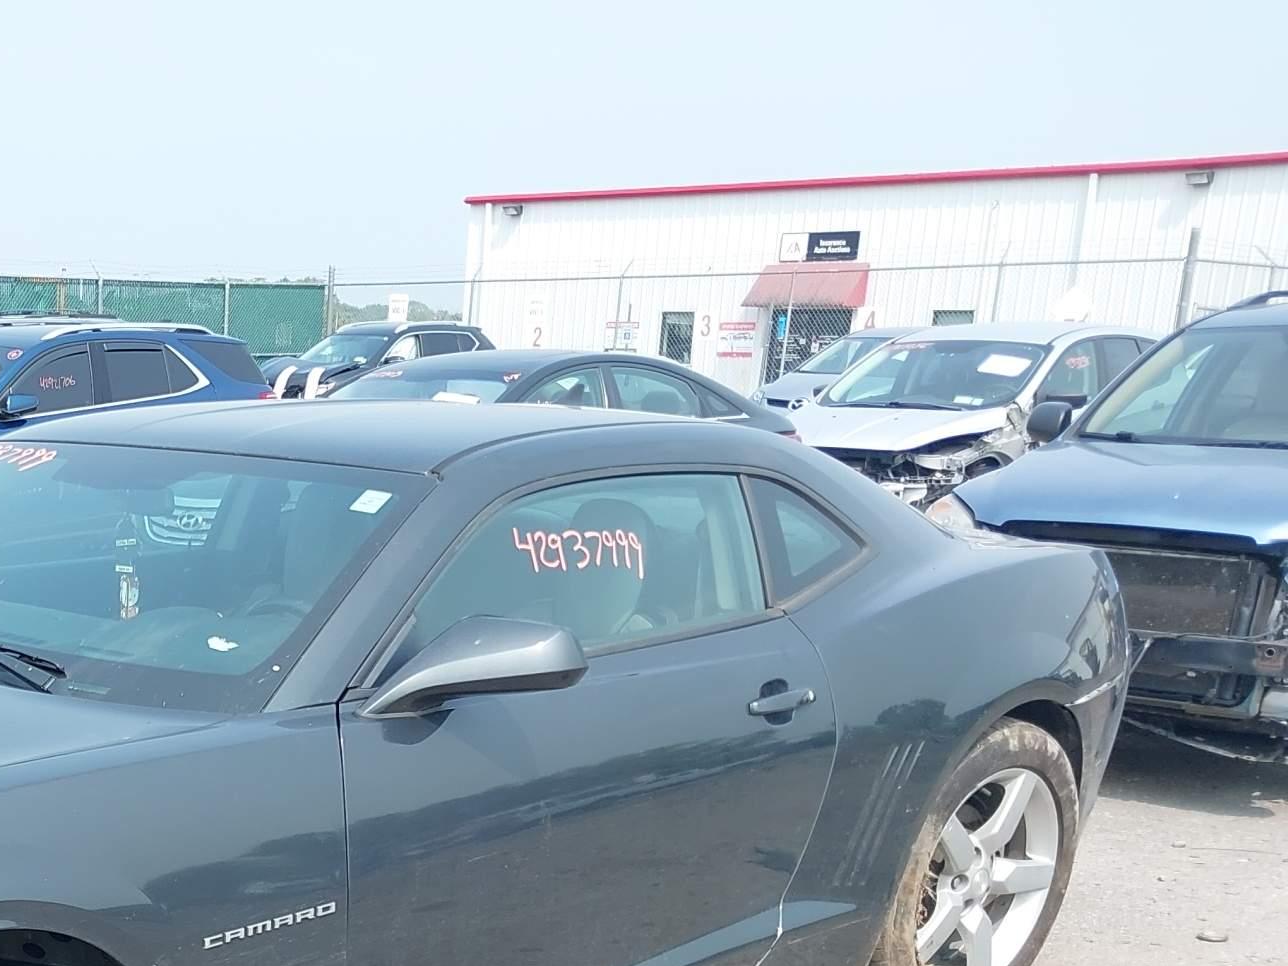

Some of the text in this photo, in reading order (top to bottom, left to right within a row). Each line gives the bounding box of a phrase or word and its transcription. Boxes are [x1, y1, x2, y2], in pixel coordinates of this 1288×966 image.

[532, 327, 543, 347] 2
[700, 315, 711, 336] 3
[512, 527, 645, 579] 42937999
[203, 901, 336, 949] CAMARO
